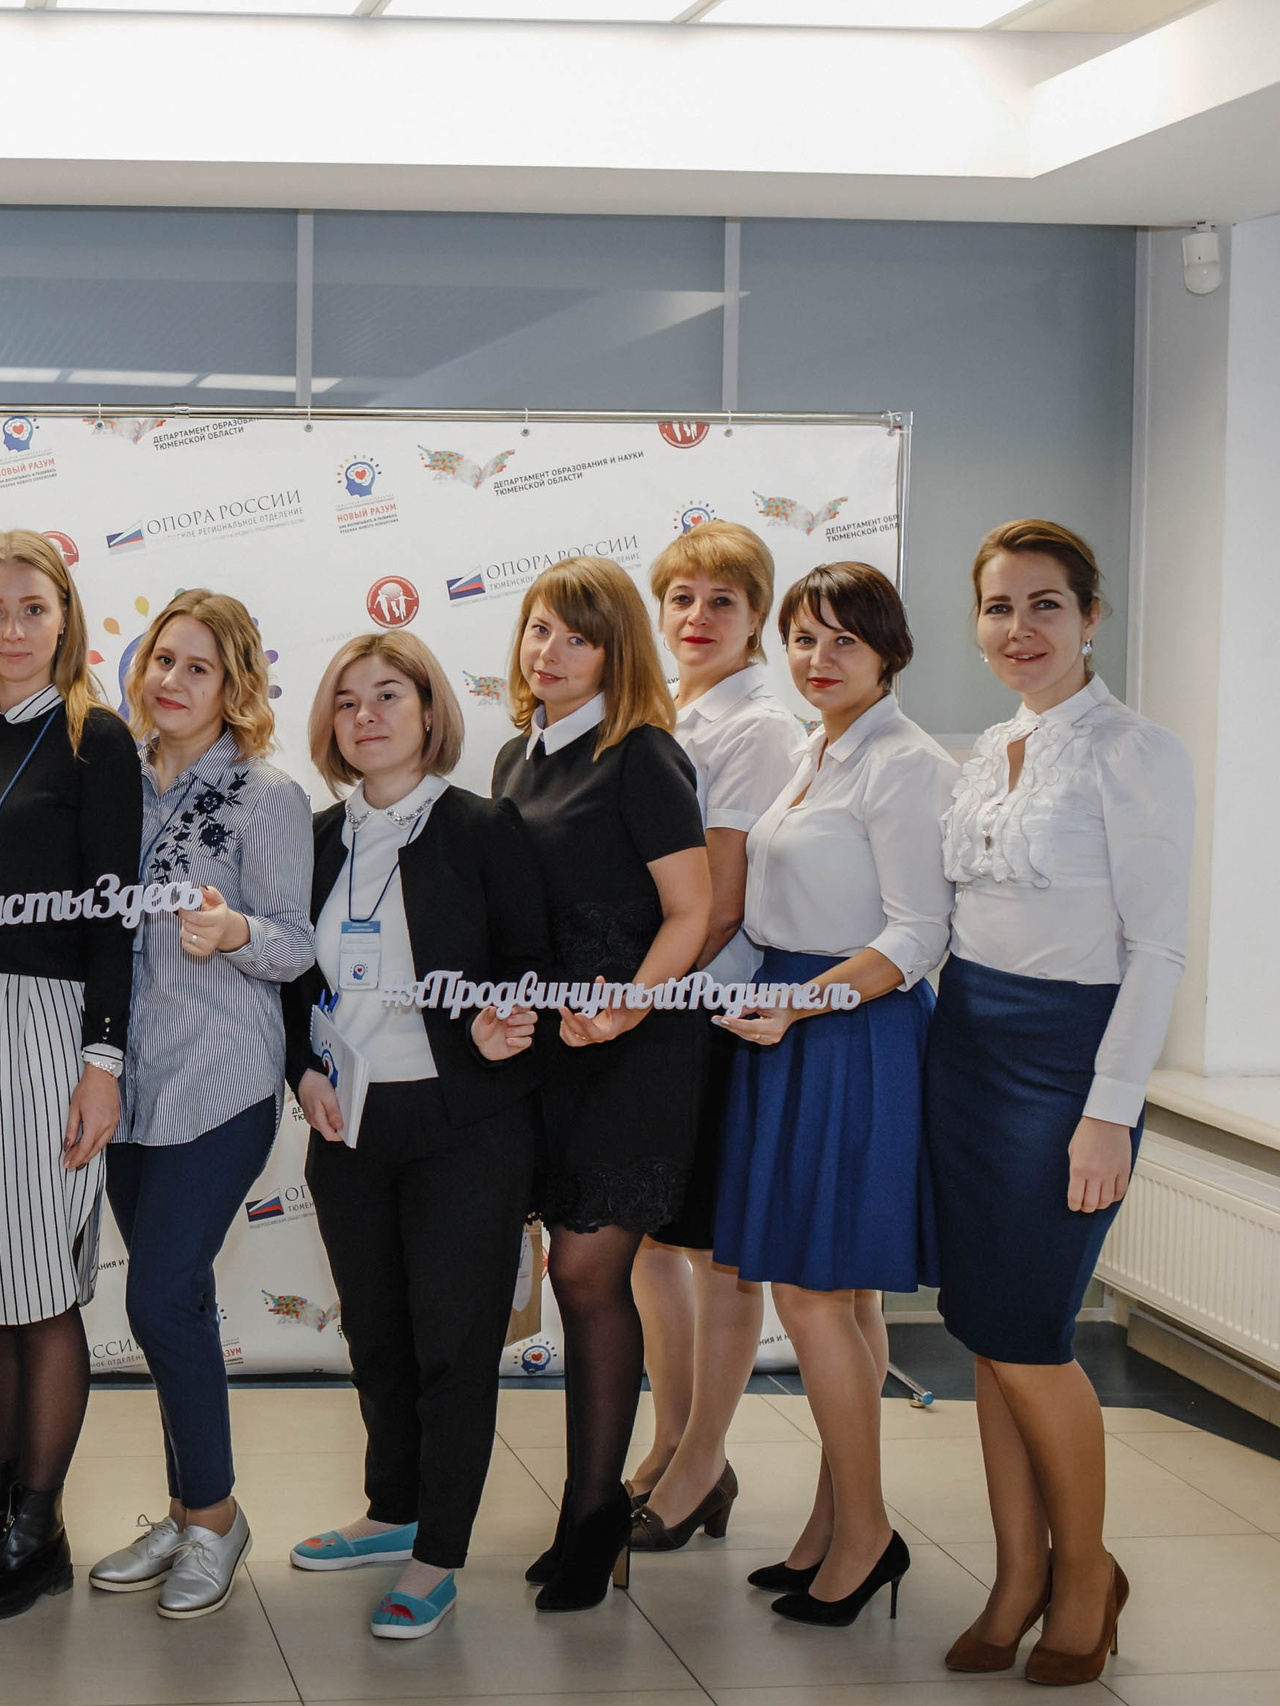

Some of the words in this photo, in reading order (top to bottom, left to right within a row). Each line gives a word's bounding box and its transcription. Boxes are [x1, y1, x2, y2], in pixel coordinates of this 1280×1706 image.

[153, 425, 210, 444] ДЕПАРТАМЕНТ
[154, 434, 206, 451] ТЮМЕНСКОЙ
[208, 426, 244, 440] ОБЛАСТИ
[28, 458, 55, 470] РАЗУМ
[493, 471, 550, 489] ДЕПАРТАМЕНТ
[551, 458, 608, 477] ОБРАЗОВАНИЯ
[617, 451, 644, 463] НАУКИ
[494, 479, 545, 497] ТЮМЕНСКОЙ
[547, 472, 583, 486] ОБЛАСТИ
[147, 508, 215, 535] ОПОРА
[218, 489, 301, 520] РОССИИ
[198, 517, 258, 536] РЕГИОНАЛЬНОЕ
[259, 507, 304, 523] ОТДЕЛЕНИЕ
[337, 508, 368, 523] НОВЫЙ
[370, 503, 397, 515] РАЗУМ
[825, 517, 881, 536] ДЕПАРТАМЕНТ
[826, 527, 878, 543] ТЮМЕНСКОЙ
[879, 522, 900, 532] ОБЛА
[486, 553, 553, 580] ОПОРА
[489, 576, 535, 592] ТЮМЕНСКОЕ
[107, 1354, 146, 1366] ОТДЕЛЕН
